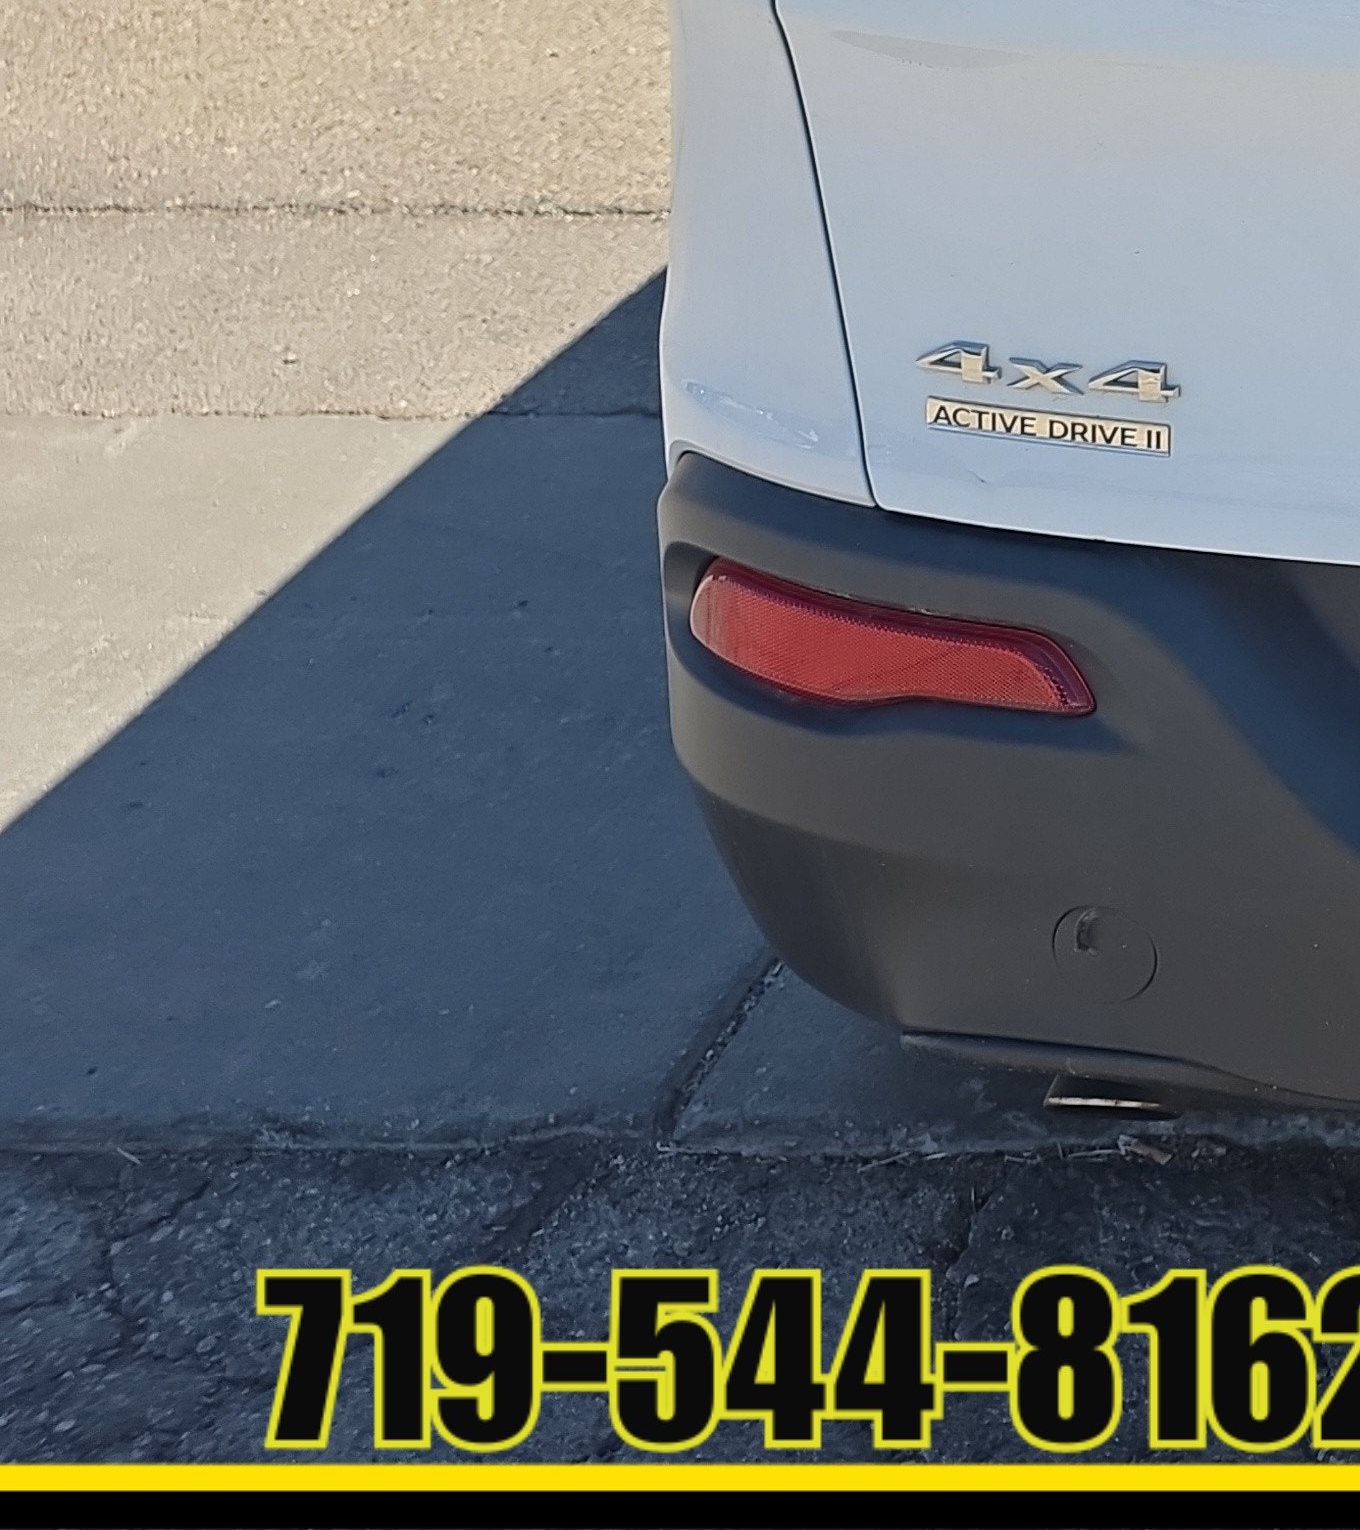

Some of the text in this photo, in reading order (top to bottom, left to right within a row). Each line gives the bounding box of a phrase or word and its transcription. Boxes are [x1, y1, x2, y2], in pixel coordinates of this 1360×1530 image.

[915, 339, 1181, 403] 4x4
[932, 405, 1037, 437] ACTIVE
[1049, 420, 1137, 448] DRIVE
